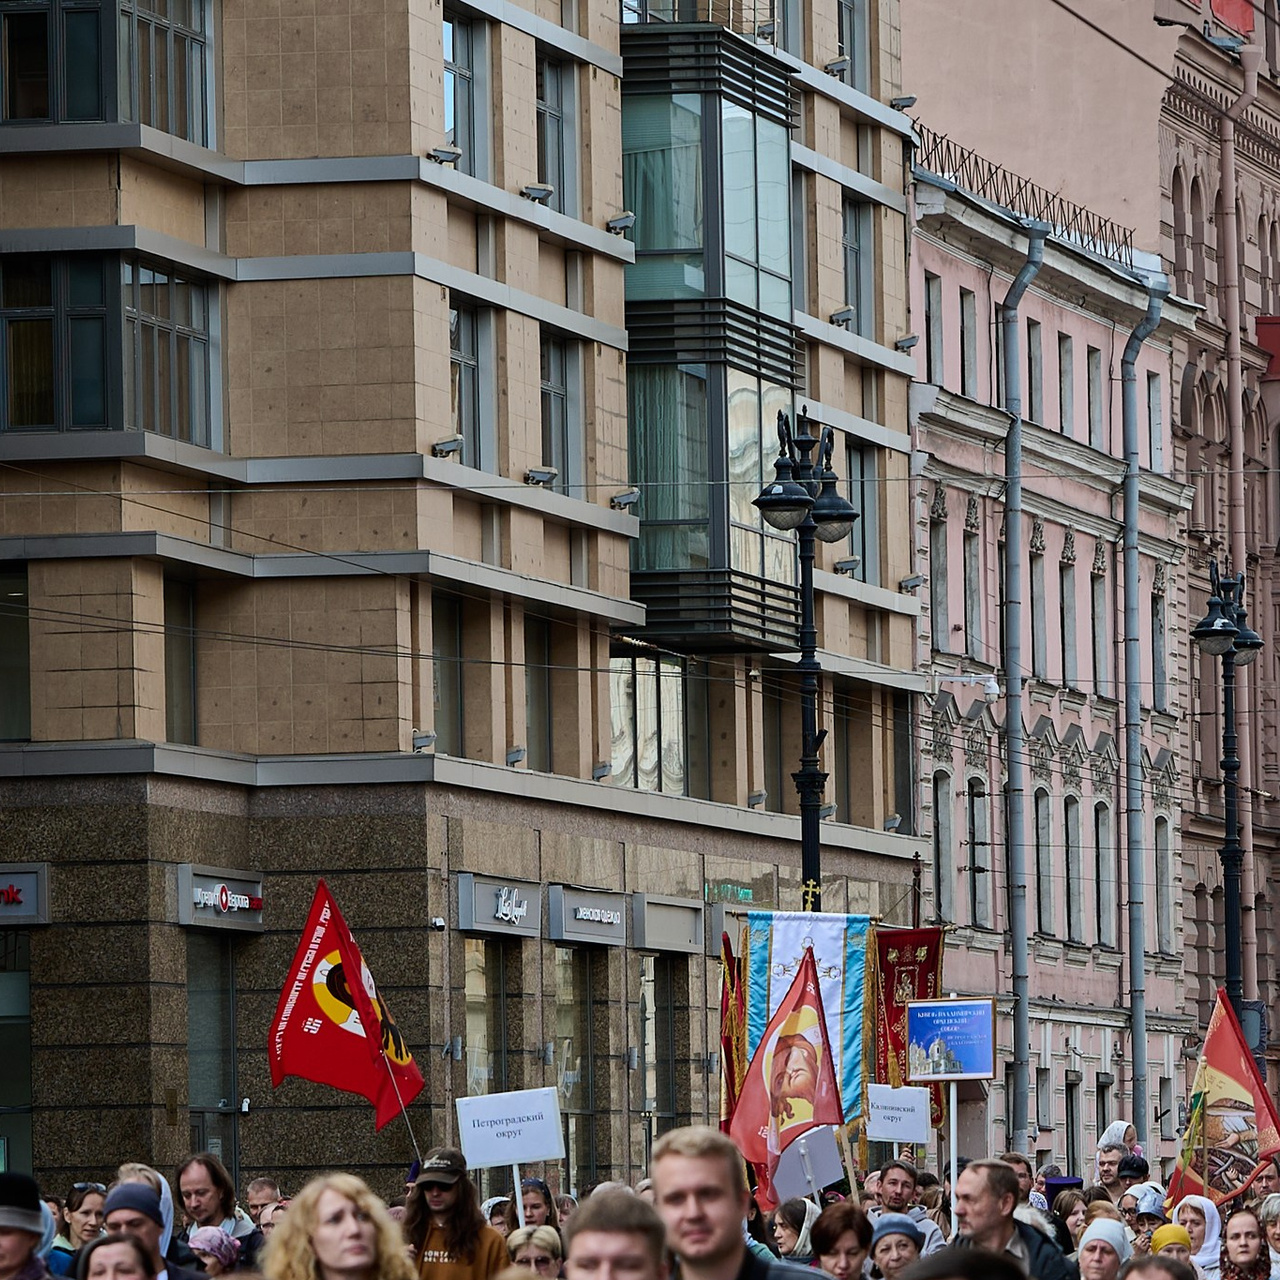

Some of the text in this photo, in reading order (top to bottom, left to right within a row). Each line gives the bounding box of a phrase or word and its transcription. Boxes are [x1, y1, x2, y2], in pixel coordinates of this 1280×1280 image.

[472, 1112, 544, 1129] Петроградский
[882, 1115, 902, 1123] округ
[495, 1128, 523, 1139] округ
